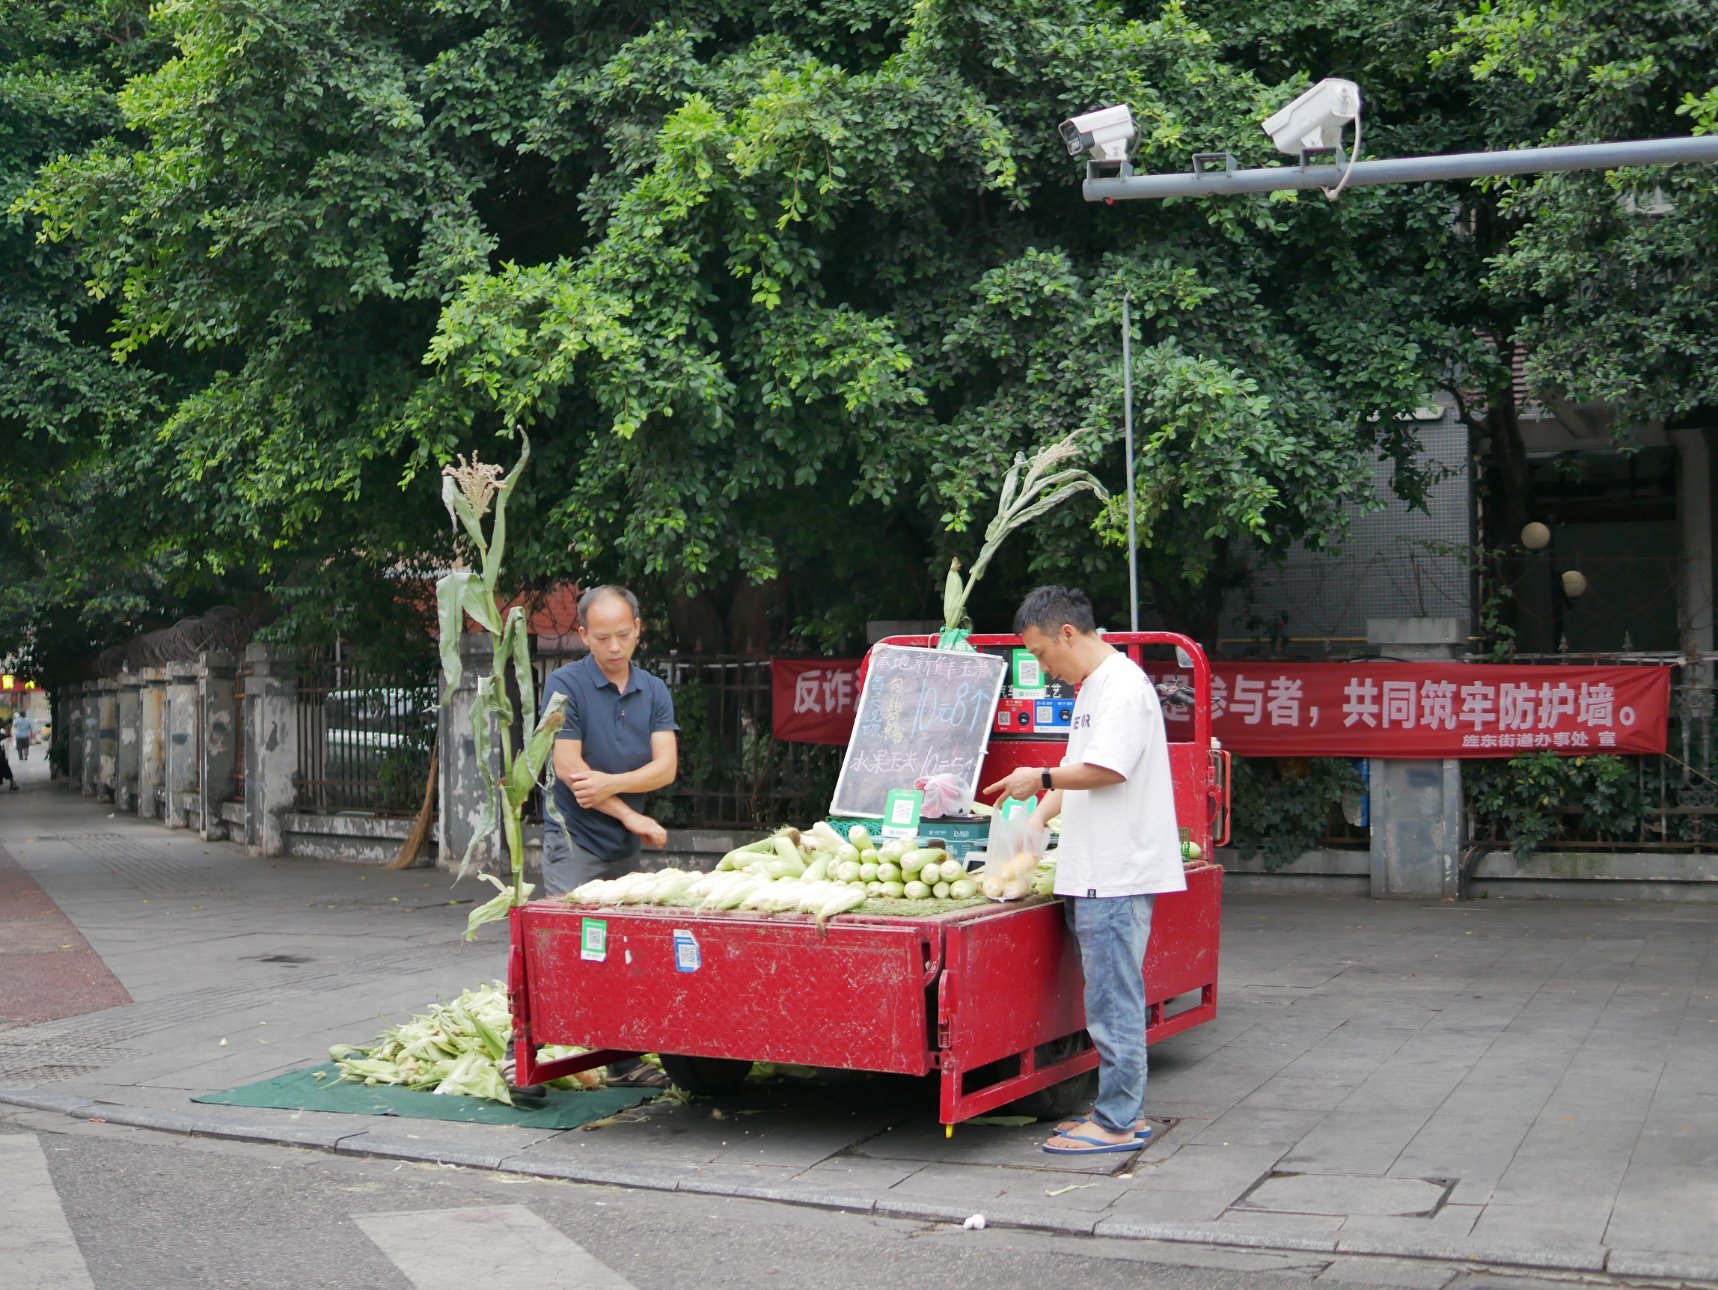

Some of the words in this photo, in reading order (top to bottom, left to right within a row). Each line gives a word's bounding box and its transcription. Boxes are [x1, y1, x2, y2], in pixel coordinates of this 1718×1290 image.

[793, 667, 862, 714] 反诈
[1462, 731, 1589, 748] 旌东街道办事处
[1598, 731, 1617, 747] 宣
[849, 750, 918, 774] 水果玉米
